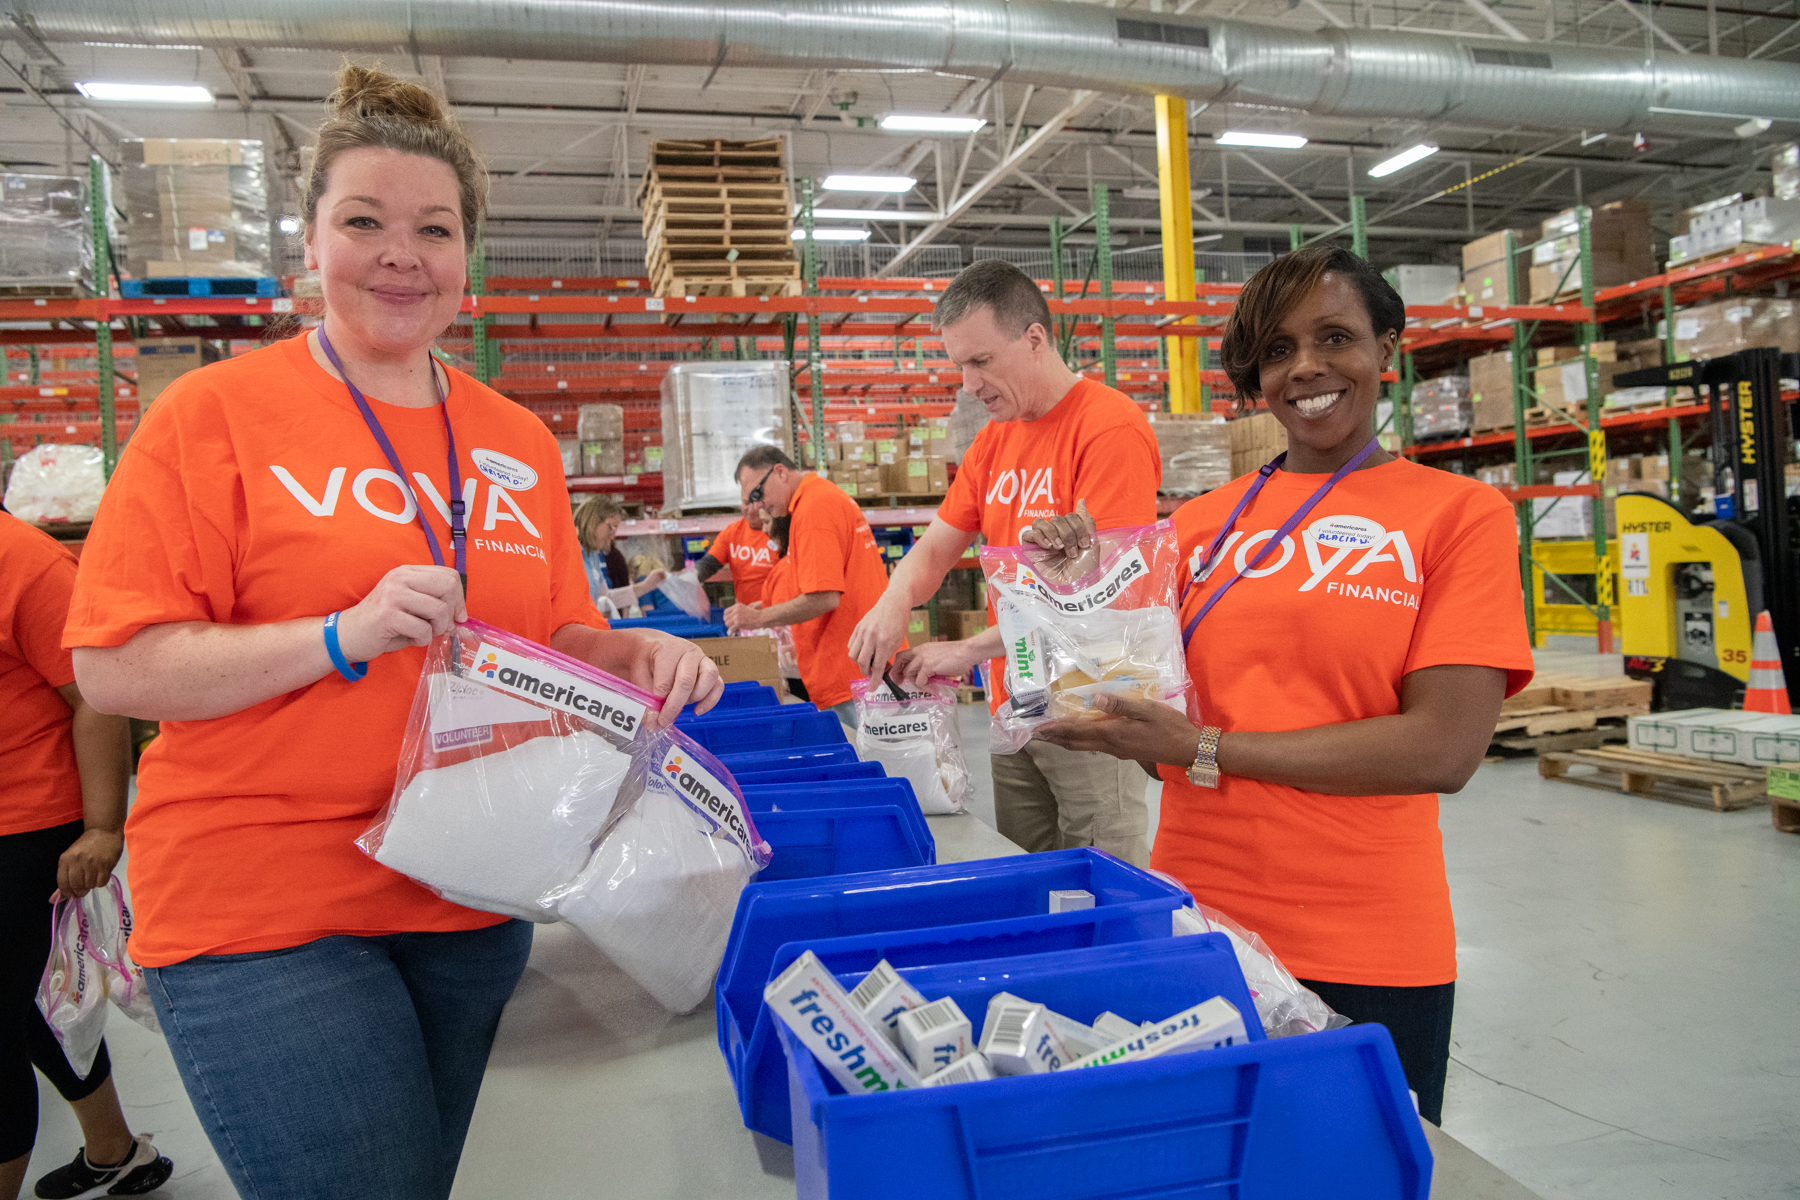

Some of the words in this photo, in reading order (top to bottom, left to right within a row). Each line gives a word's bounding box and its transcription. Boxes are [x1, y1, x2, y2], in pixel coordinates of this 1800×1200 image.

[1737, 380, 1757, 465] HYSTER
[985, 467, 1055, 518] VOYA
[268, 465, 541, 550] VOYA
[1317, 533, 1357, 543] ALACIA
[1321, 529, 1356, 538] volunteered
[1334, 524, 1367, 532] americares
[1622, 521, 1672, 533] HYSTER
[730, 542, 771, 567] VOYA
[1326, 581, 1420, 611] FINANCIAL
[1722, 648, 1748, 664] 35
[498, 667, 637, 733] americares
[435, 725, 490, 746] VOLUNTEER
